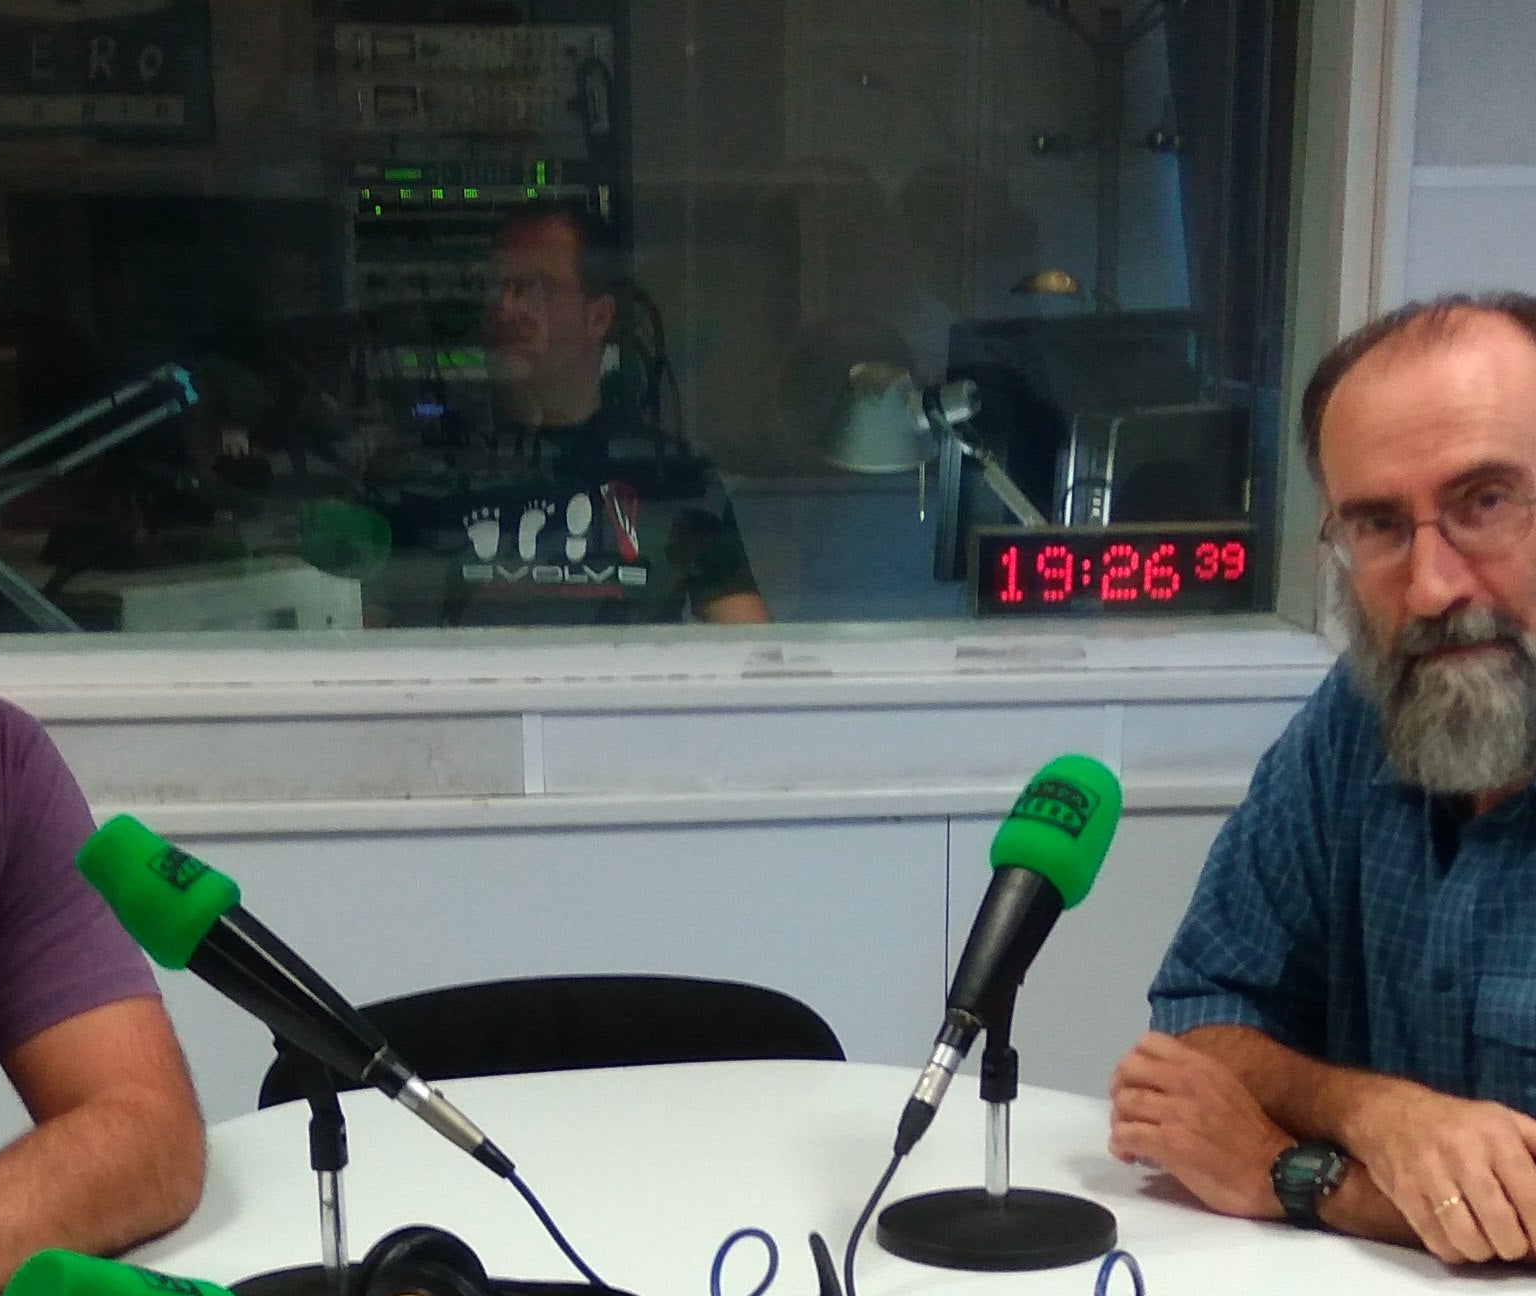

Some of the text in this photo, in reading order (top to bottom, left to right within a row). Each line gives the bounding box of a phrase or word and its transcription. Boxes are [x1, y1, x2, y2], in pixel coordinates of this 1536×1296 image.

[462, 563, 647, 586] EVOLVE
[999, 542, 1246, 602] 19:26 39
